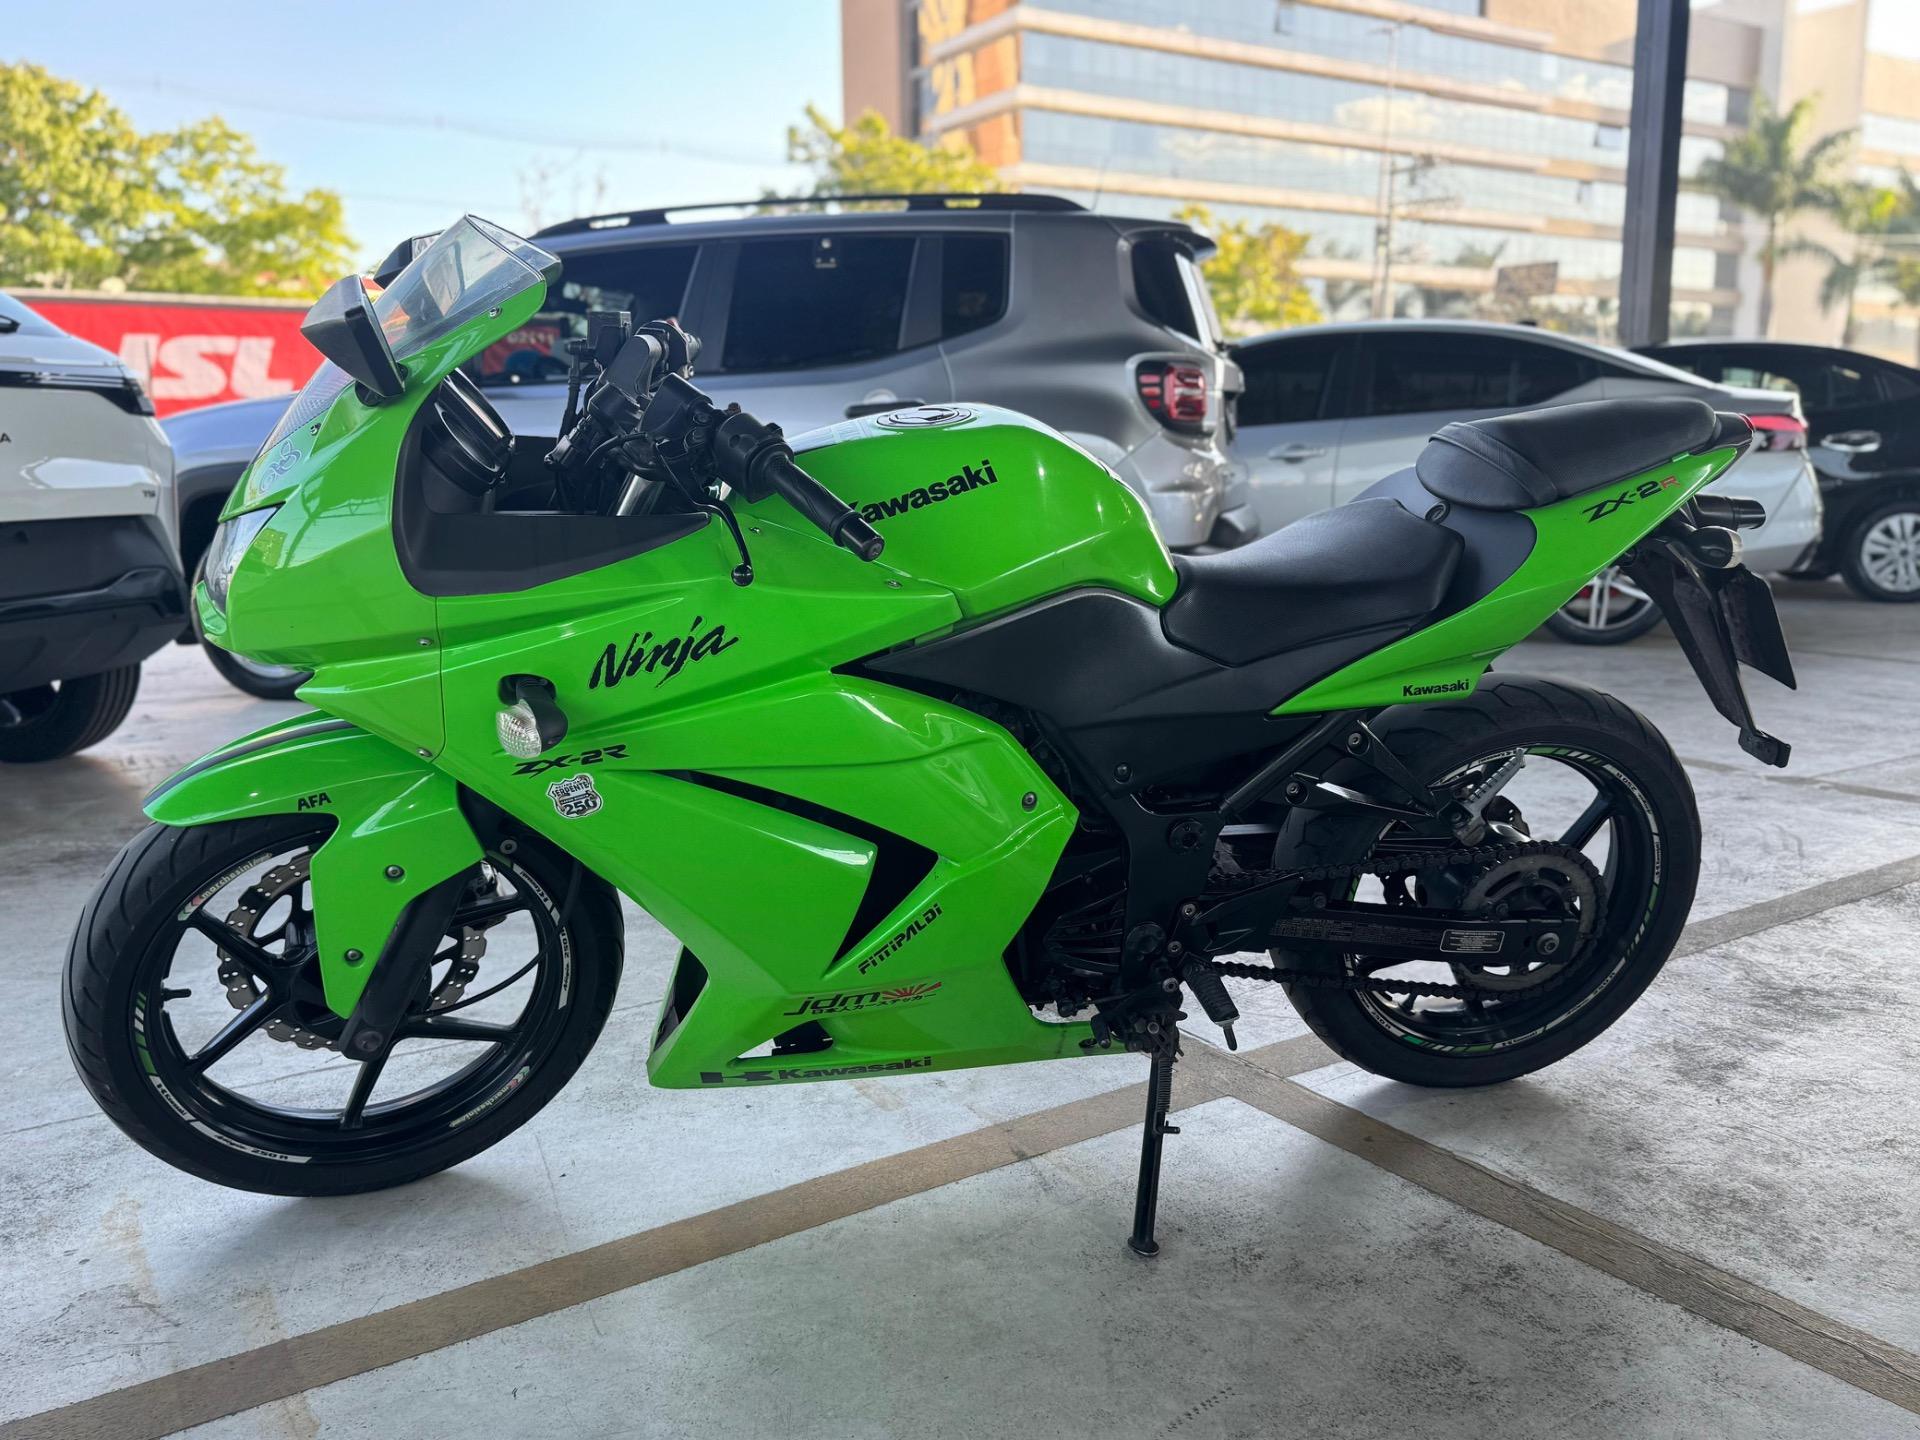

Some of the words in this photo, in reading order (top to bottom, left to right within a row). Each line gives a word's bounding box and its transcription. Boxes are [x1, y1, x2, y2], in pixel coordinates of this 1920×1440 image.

[1581, 476, 1681, 523] ZX-2R
[588, 615, 740, 690] Ninja
[1402, 679, 1470, 697] Kawasaki
[511, 744, 630, 779] ZX-2R
[297, 791, 332, 811] AFA
[563, 797, 598, 816] 250
[784, 991, 881, 1016] jdm
[778, 1056, 932, 1080] Kawasaki
